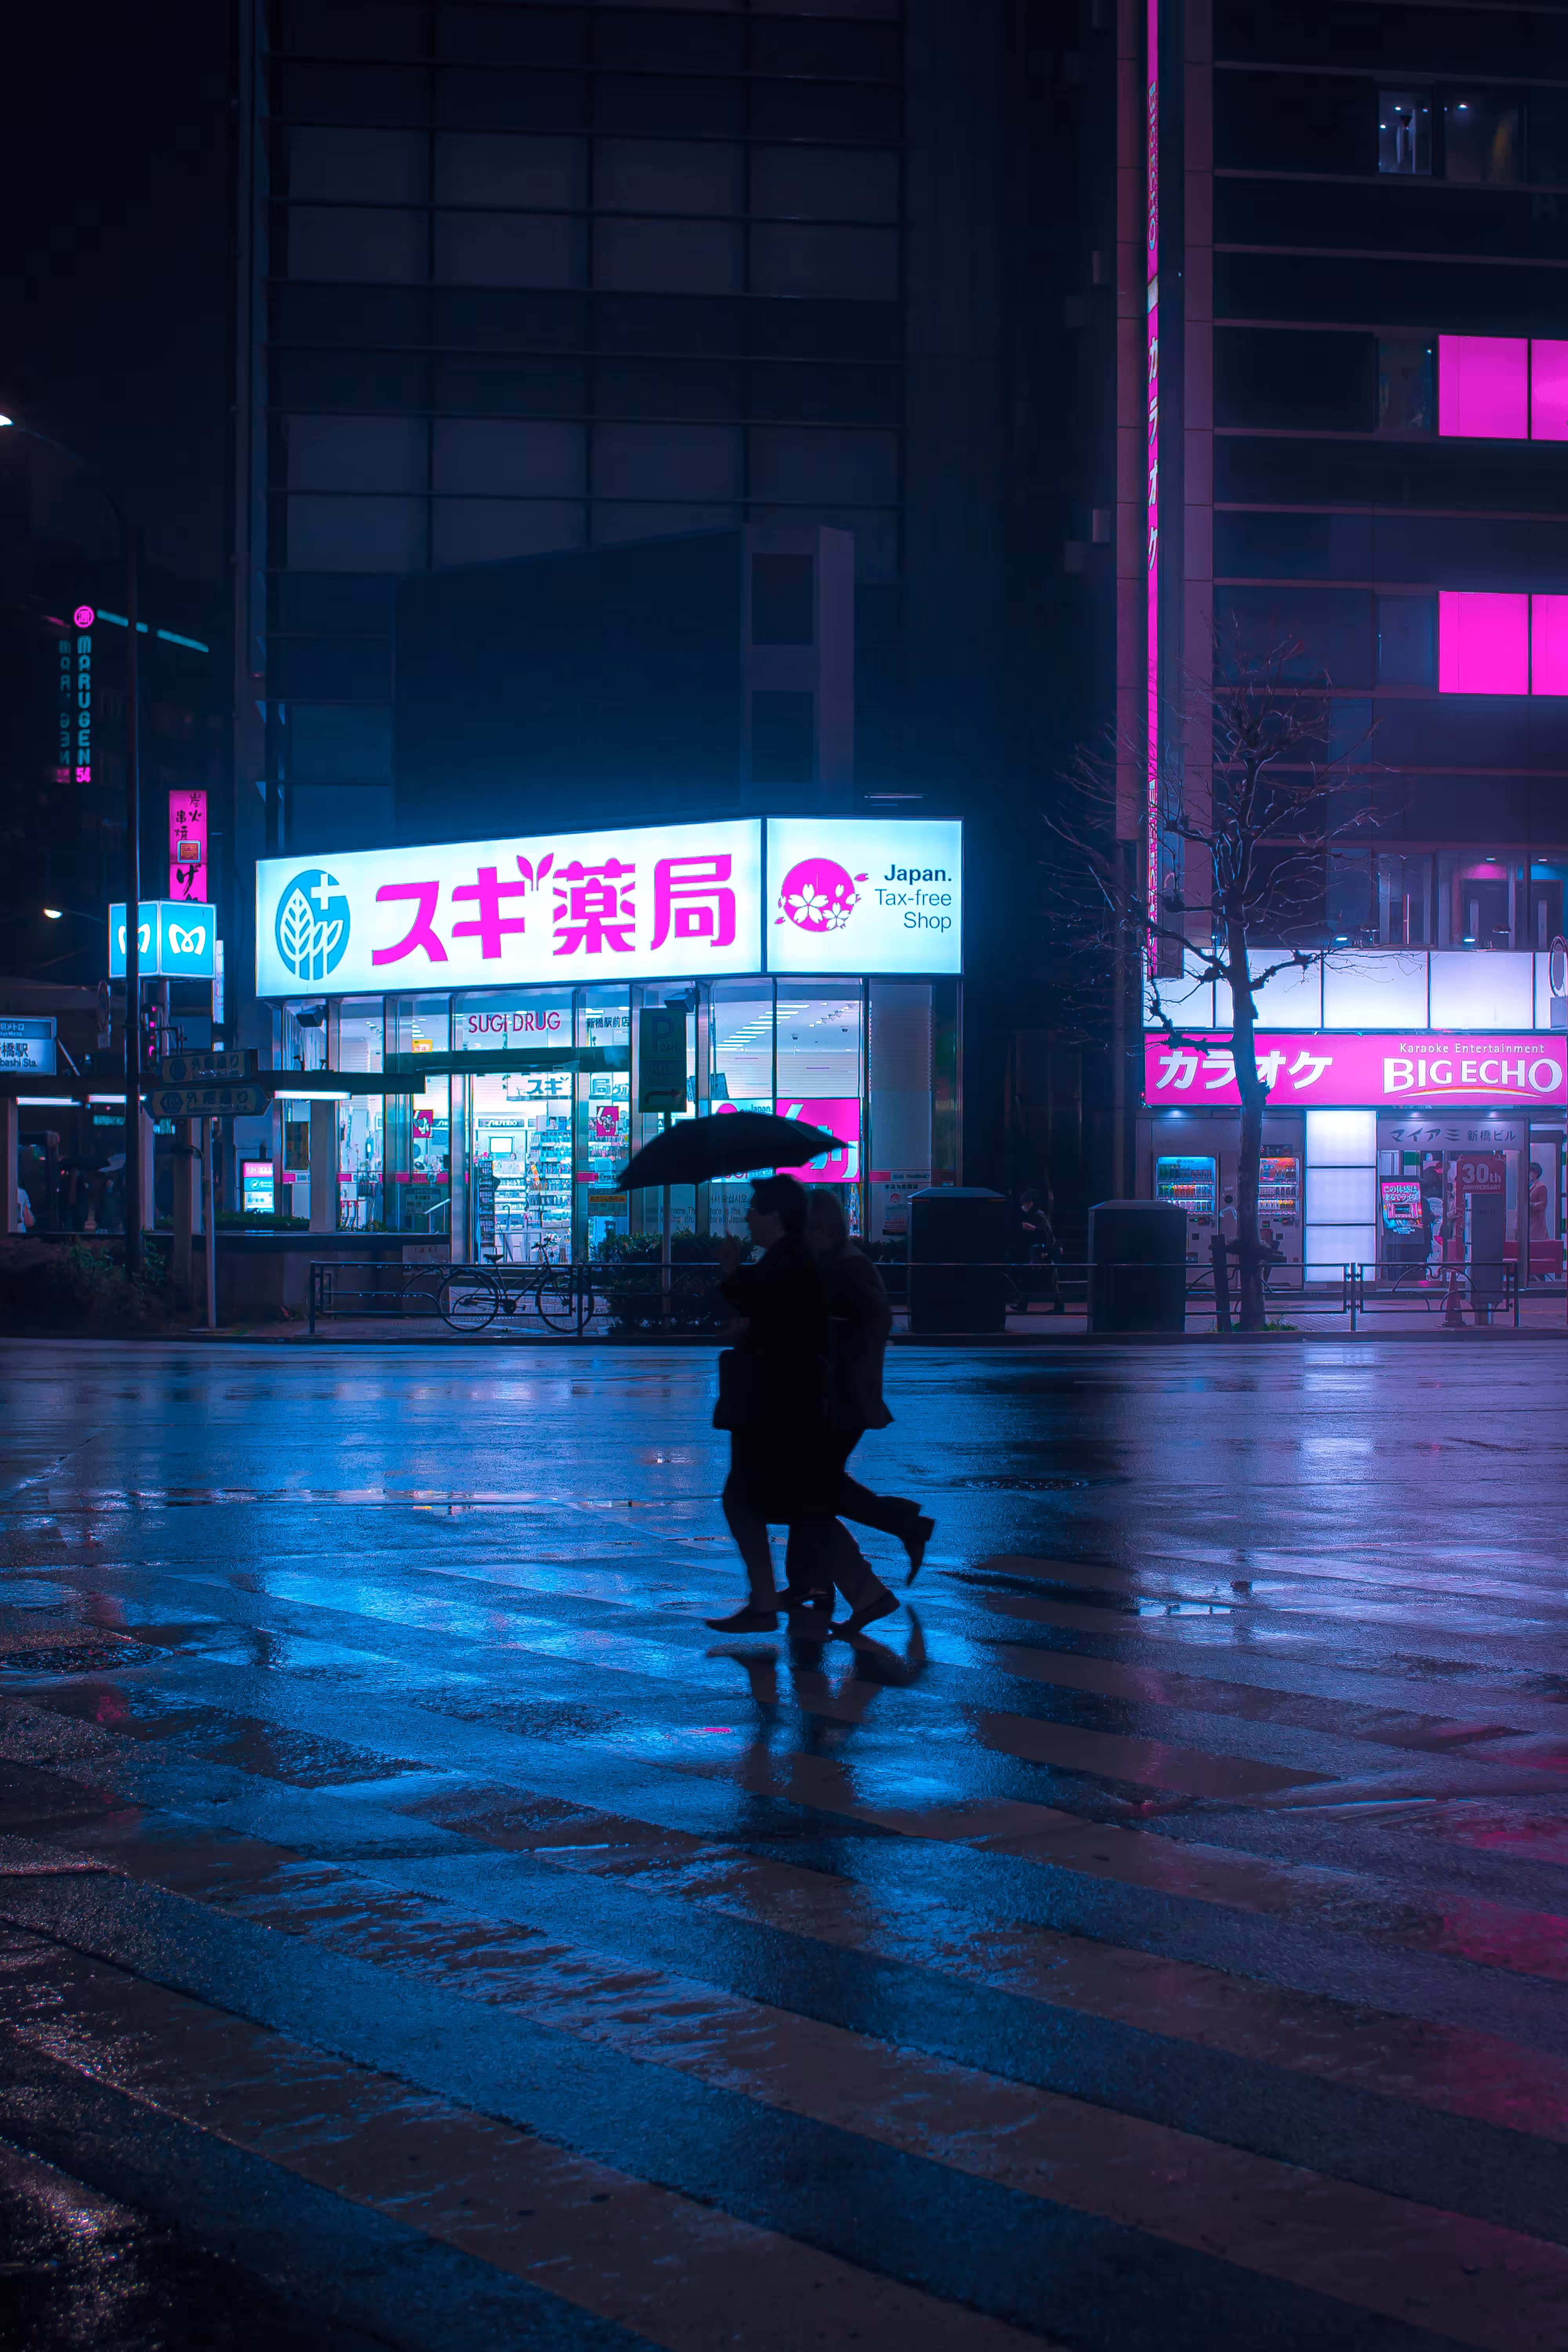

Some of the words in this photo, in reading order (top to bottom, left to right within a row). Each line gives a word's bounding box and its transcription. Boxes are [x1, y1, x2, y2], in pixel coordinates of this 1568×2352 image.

[1148, 336, 1158, 571] カラオケ
[77, 635, 91, 766] MARUGEN
[189, 793, 203, 822] 炭火
[884, 864, 952, 884] Japan.
[875, 889, 952, 906] Tax-free
[372, 853, 735, 966] スギ薬局
[904, 912, 952, 933] Shop
[469, 1013, 508, 1033] SUGI
[513, 1011, 561, 1032] DRUG
[586, 1016, 630, 1029] 新橋駅前店
[652, 1016, 675, 1053] P
[0, 1041, 29, 1058] 橋駅
[1399, 1043, 1449, 1053] Karaoke
[1454, 1043, 1544, 1053] Entertainment
[1155, 1049, 1334, 1090] カラオケ
[1383, 1057, 1453, 1094] BIG
[1460, 1058, 1563, 1093] ECHO
[1388, 1128, 1461, 1142] マイアミ
[1468, 1129, 1517, 1142] 新橋ビル
[1462, 1163, 1502, 1184] 30th
